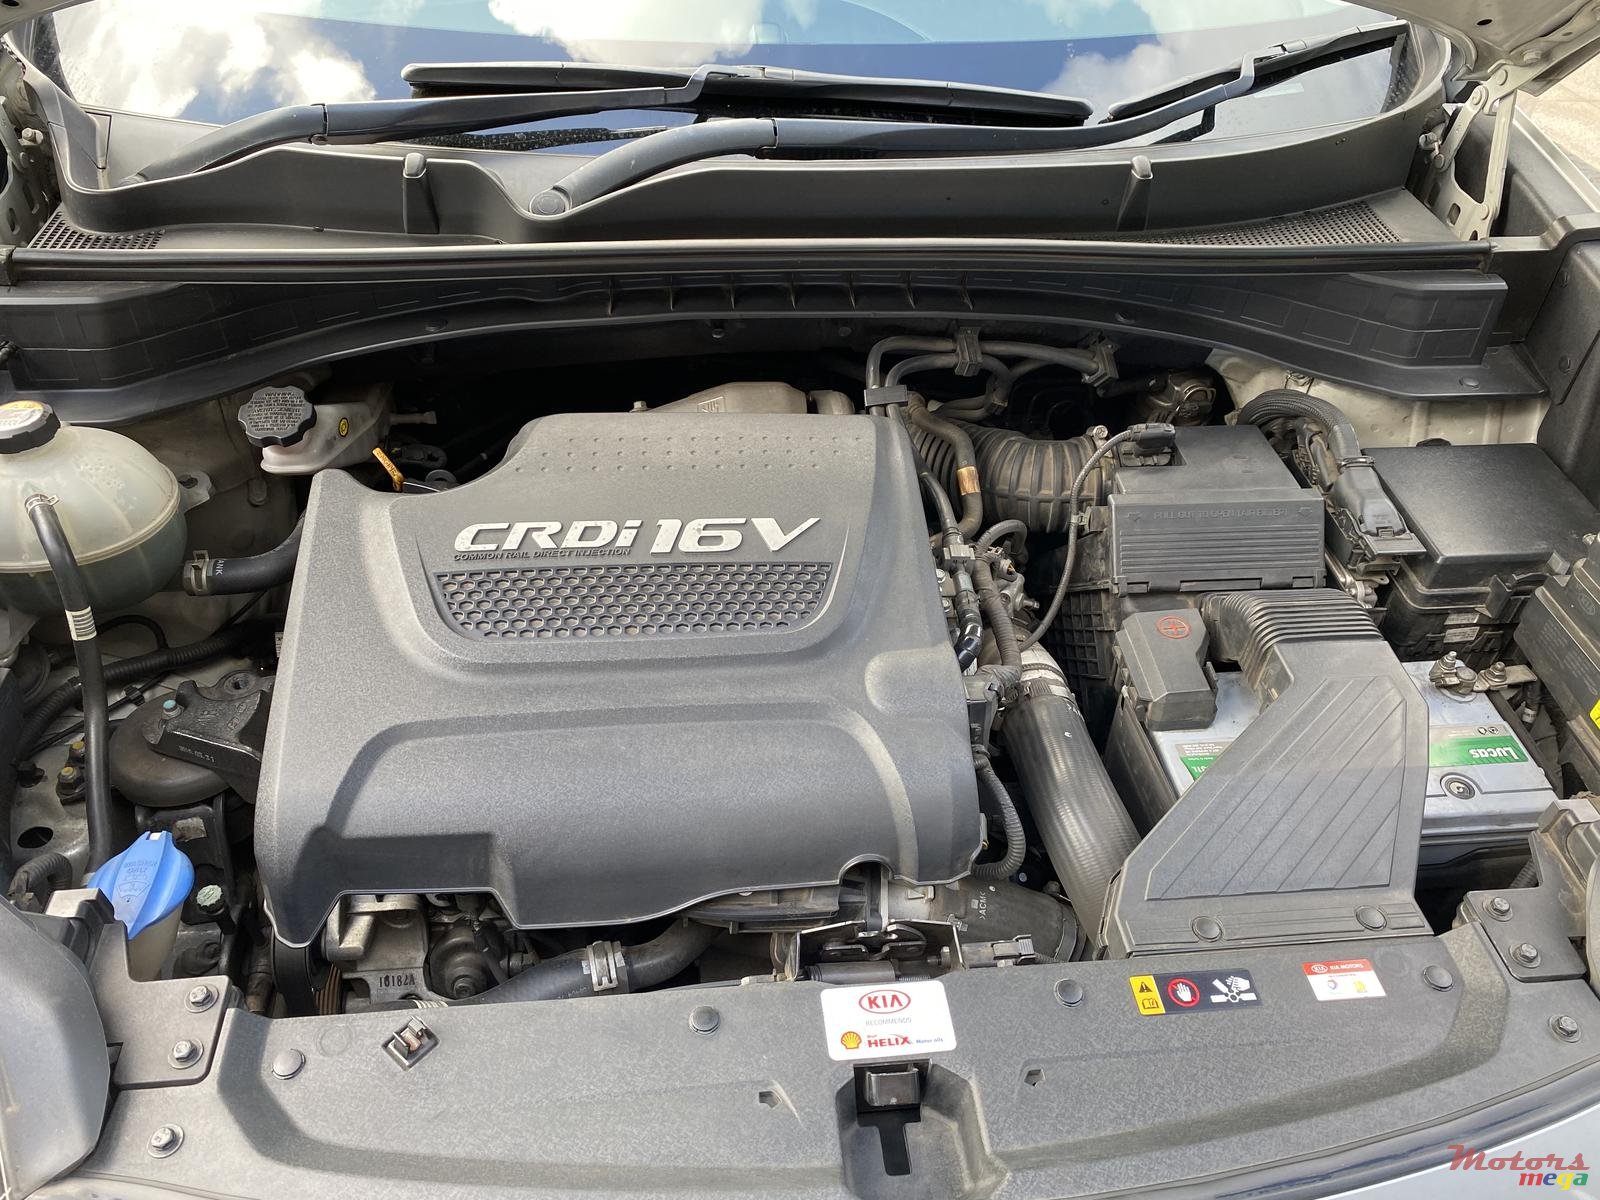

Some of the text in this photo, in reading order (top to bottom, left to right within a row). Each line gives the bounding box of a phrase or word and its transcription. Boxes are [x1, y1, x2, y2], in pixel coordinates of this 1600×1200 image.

[454, 517, 821, 553] CRDi 16V
[453, 548, 631, 561] COMMON RAIL DIRECT INJECTION
[1469, 746, 1519, 760] Lucas
[867, 994, 903, 1009] KIA
[867, 1036, 912, 1048] HELIX
